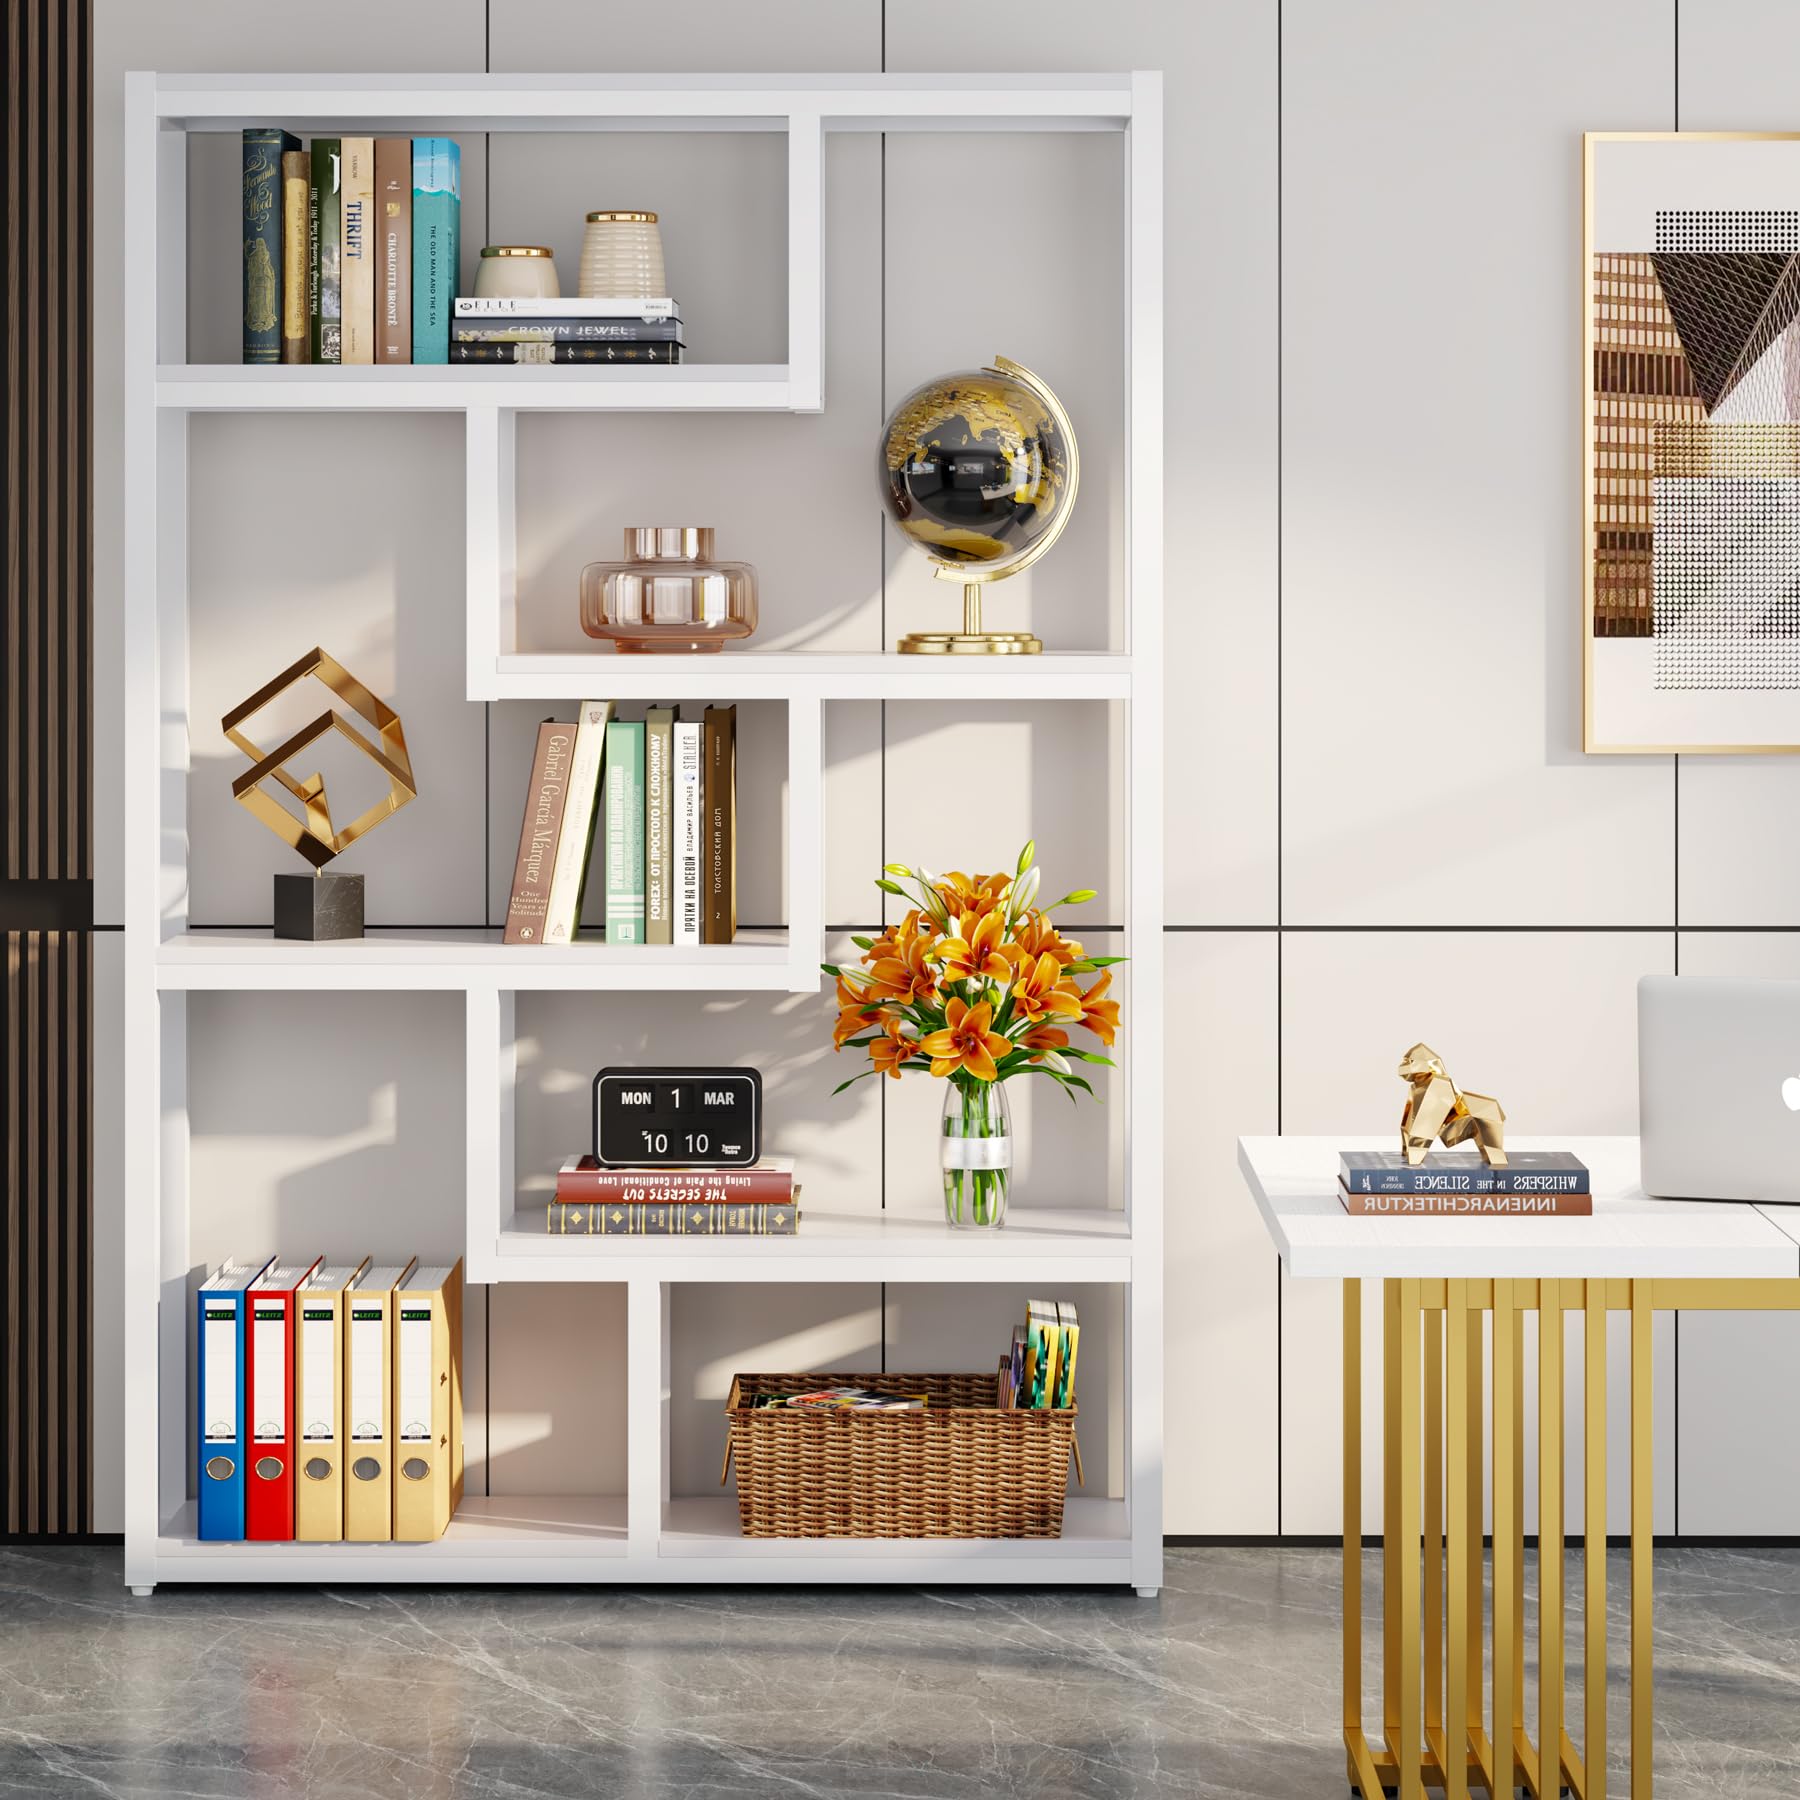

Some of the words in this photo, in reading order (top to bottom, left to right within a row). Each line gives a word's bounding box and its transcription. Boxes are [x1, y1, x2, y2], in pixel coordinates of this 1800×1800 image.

[347, 201, 362, 259] THRIFT
[311, 242, 319, 266] Yesterday
[387, 233, 397, 288] CHARLOTTE
[576, 327, 628, 335] JEWEL
[544, 736, 568, 781] Gabriel
[651, 734, 660, 795] СЛОЖНОМУ
[536, 785, 560, 825] García
[651, 810, 660, 860] ПРОСТОГО
[524, 830, 552, 883] Márquez
[651, 863, 660, 876] ОТ
[683, 856, 695, 886] ОСЕВОЙ
[651, 880, 660, 920] FOREX:
[684, 889, 695, 899] НА
[684, 903, 695, 932] ПРЯТКИ
[621, 1092, 652, 1105] MON
[671, 1088, 679, 1108] 1
[704, 1092, 735, 1105] MAR
[644, 1134, 668, 1153] 10
[685, 1134, 709, 1153] 10
[598, 1177, 617, 1186] Love
[621, 1177, 669, 1186] Conditional
[674, 1177, 682, 1186] of
[686, 1177, 704, 1186] Pain
[708, 1177, 721, 1186] the
[726, 1176, 751, 1186] Living
[623, 1189, 645, 1200] OUT
[649, 1189, 701, 1200] SECRETS
[705, 1189, 726, 1200] THE
